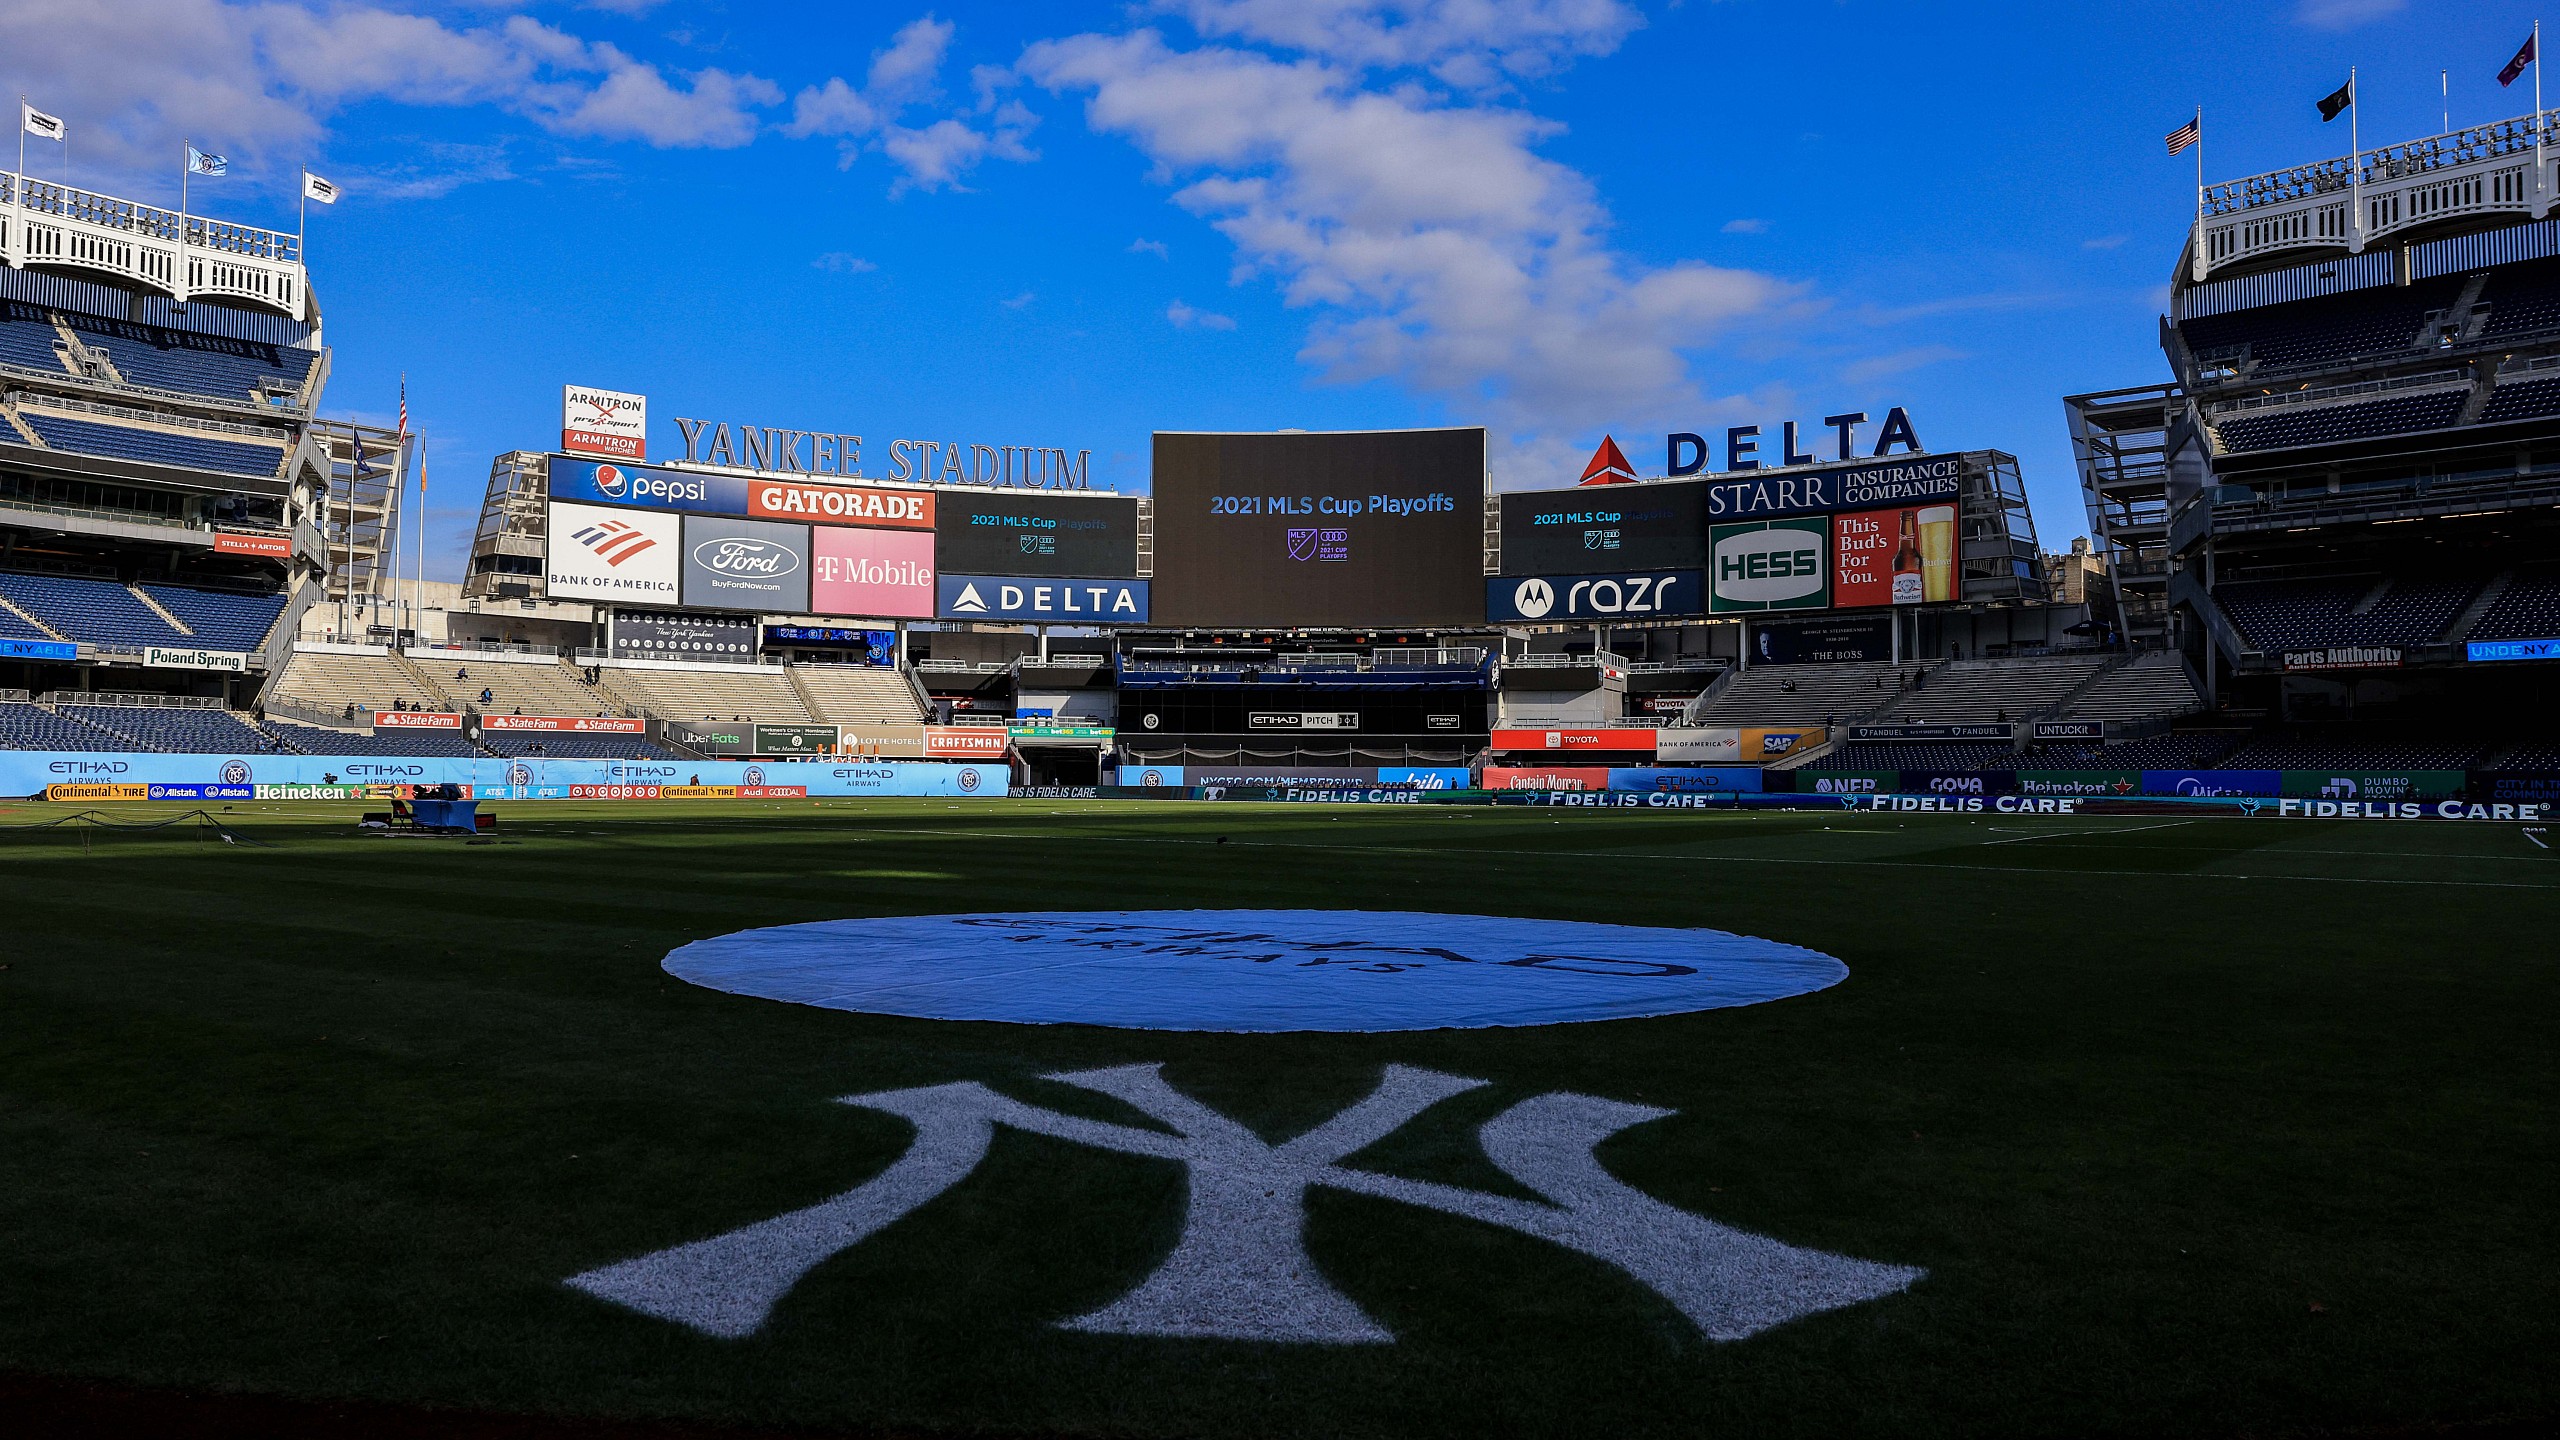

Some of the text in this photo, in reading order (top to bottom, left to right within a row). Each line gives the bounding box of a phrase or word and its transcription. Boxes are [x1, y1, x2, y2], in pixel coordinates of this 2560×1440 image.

[569, 393, 641, 411] ARMITRON
[606, 420, 639, 428] sport
[572, 433, 637, 449] ARMITRON
[1667, 406, 1924, 477] DELTA
[604, 445, 636, 455] WATCHES
[674, 417, 1092, 491] YANKEE STADIUM
[1845, 460, 1959, 487] INSURANCE
[632, 476, 706, 503] pepsi
[1708, 477, 1831, 515] STARR
[1845, 476, 1959, 503] COMPANIES
[761, 487, 924, 520] GATORADE
[1210, 493, 1454, 517] 2021 MLS Cup Playoffs
[971, 514, 1107, 530] 2021 MLS Cup Playoffs
[1534, 513, 1563, 525] 2021
[1566, 512, 1593, 523] MLS
[1595, 511, 1621, 523] Cup
[1839, 517, 1879, 534] This
[1840, 534, 1888, 551] Bud's
[711, 542, 781, 573] Ford
[1721, 549, 1816, 581] HESS
[1840, 552, 1869, 568] For
[844, 558, 932, 587] Mobile
[1840, 569, 1878, 584] You.
[551, 573, 675, 592] BANK OF AMERICA
[711, 579, 781, 591] BuyFordNow.com
[1001, 585, 1137, 613] DELTA
[1568, 576, 1677, 614] razr
[656, 627, 714, 640] New York Yankees
[0, 643, 74, 656] ENYABLE
[1813, 650, 1862, 660] THE BOSS
[2284, 646, 2402, 665] Parts Authority
[150, 649, 239, 670] Poland Spring
[1306, 716, 1333, 724] PITCH
[2039, 726, 2088, 734] UNTUCKit
[682, 732, 740, 744] Uber Eats
[1764, 738, 1792, 750] SAP
[49, 761, 128, 774] ETIHAD
[346, 764, 424, 776] ETIHAD
[611, 766, 676, 776] ETIHAD
[833, 769, 894, 778] ETIHAD
[1656, 776, 1718, 786] ETIHAD
[1930, 778, 1984, 792] GOYA
[2364, 778, 2409, 786] DUMBO
[2496, 780, 2526, 788] CITY
[2530, 780, 2545, 788] IN
[51, 785, 145, 800] Continental TIRE
[164, 788, 197, 797] Allstate
[218, 788, 248, 797] Allstate
[254, 785, 346, 800] Heineken
[662, 786, 708, 798] Continental
[1026, 787, 1035, 797] IS
[1036, 787, 1069, 798] FIDELIS
[1070, 787, 1097, 798] CARE.
[1286, 788, 1360, 802] FIDELIS
[1872, 795, 1984, 811] FIDELIS
[2279, 798, 2421, 818] FIDELIS
